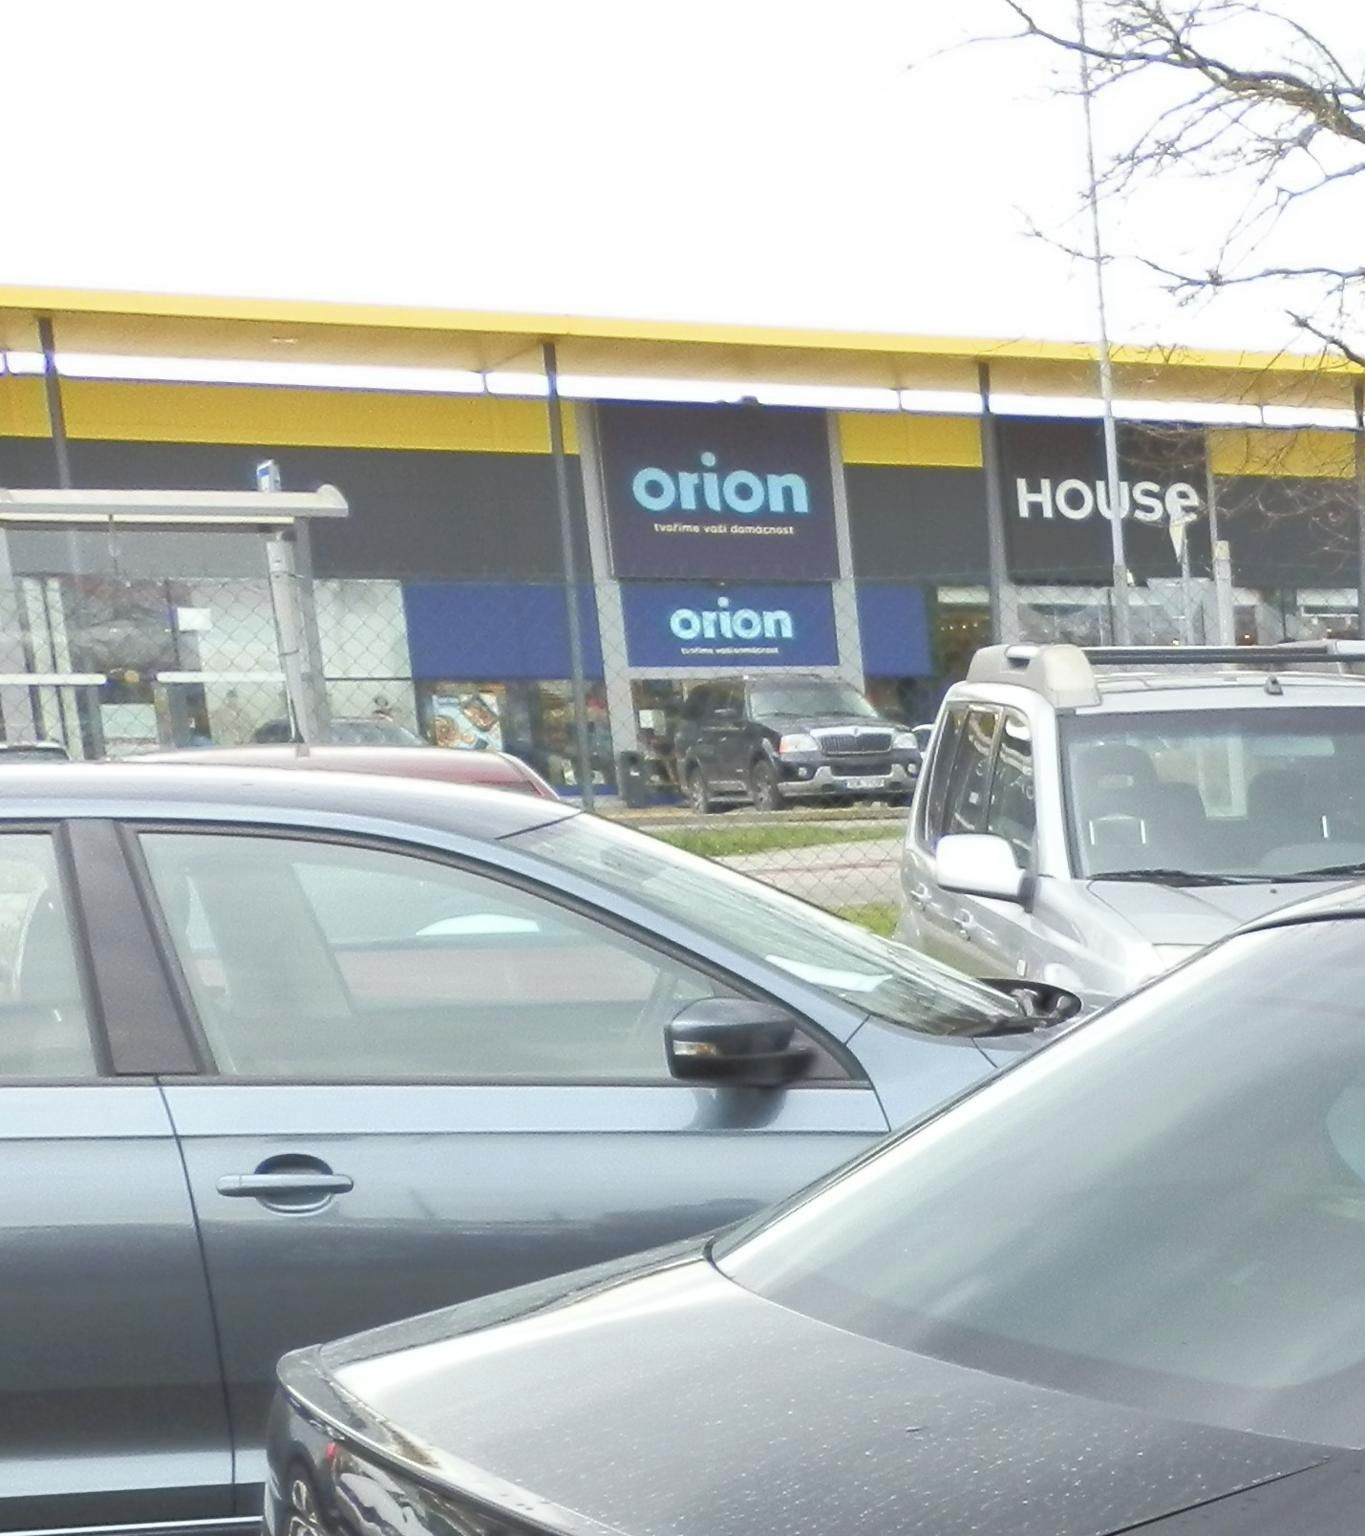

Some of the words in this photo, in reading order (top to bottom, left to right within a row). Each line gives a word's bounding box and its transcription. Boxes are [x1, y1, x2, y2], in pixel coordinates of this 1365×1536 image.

[633, 451, 809, 513] orion
[703, 523, 727, 534] vaši
[669, 596, 794, 640] orion
